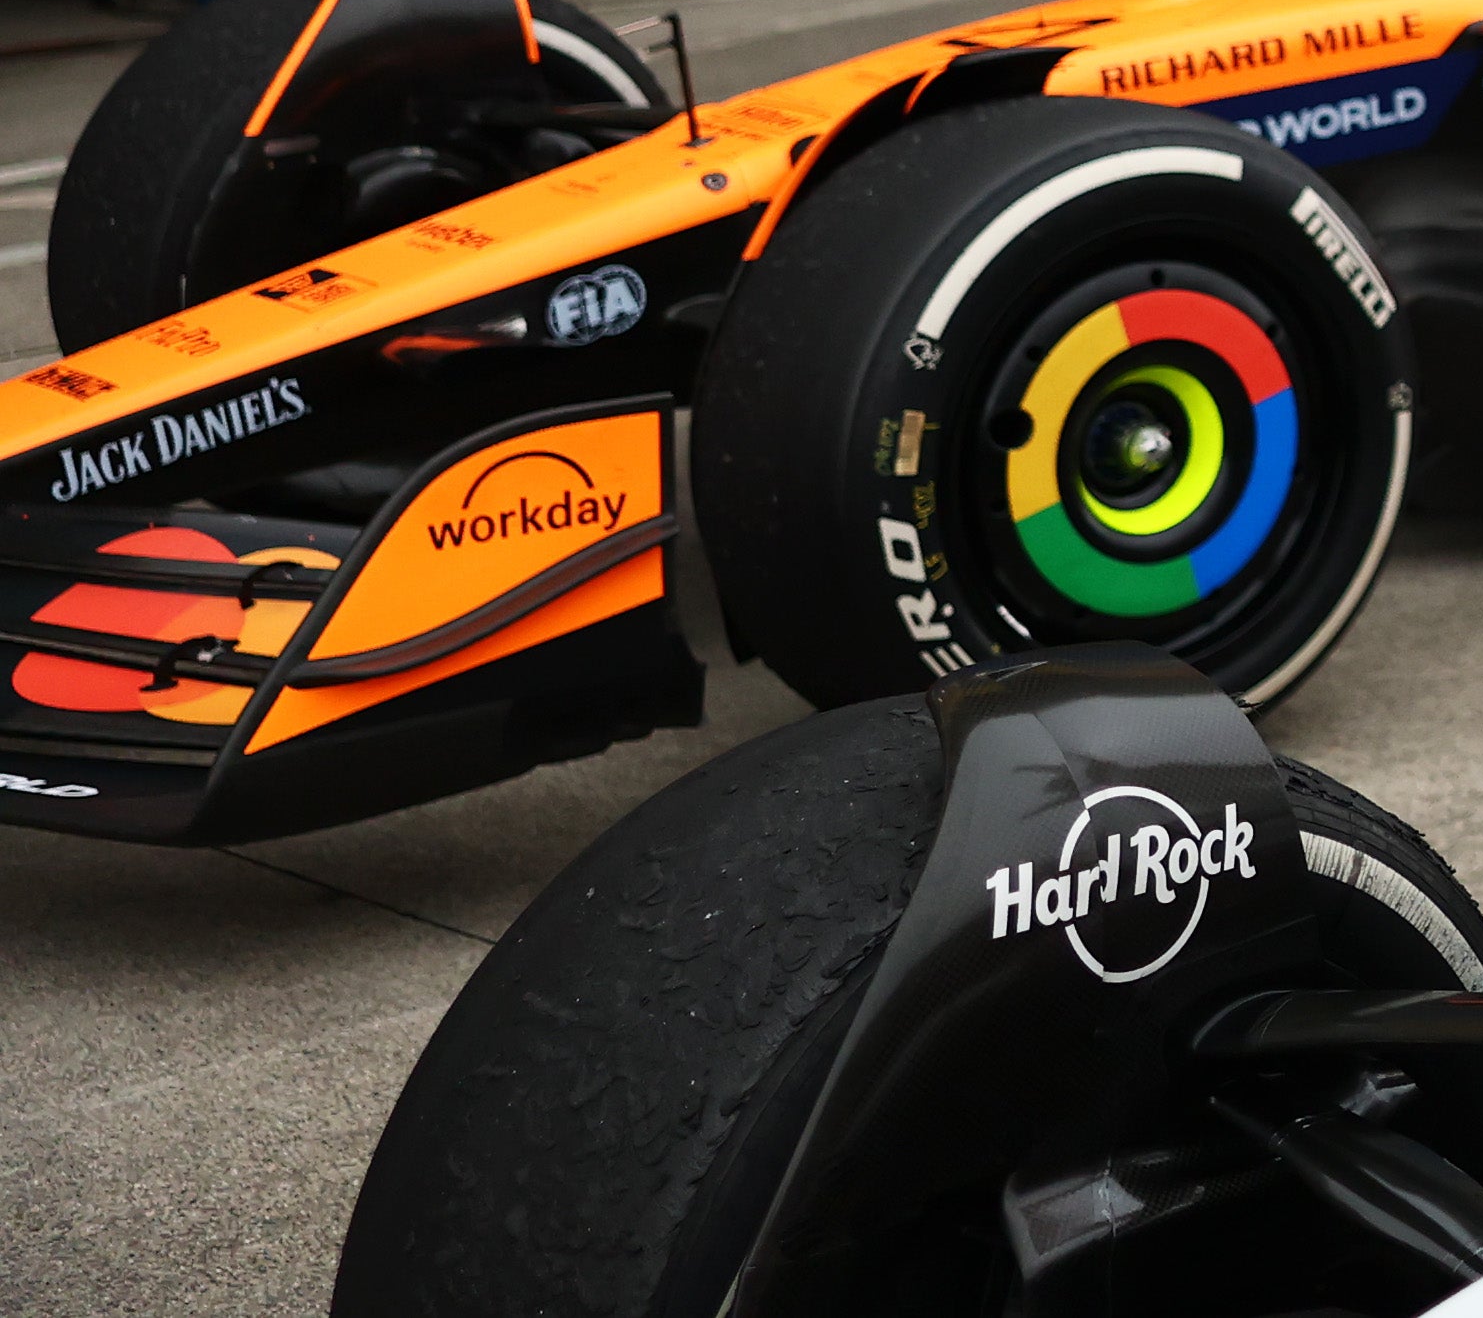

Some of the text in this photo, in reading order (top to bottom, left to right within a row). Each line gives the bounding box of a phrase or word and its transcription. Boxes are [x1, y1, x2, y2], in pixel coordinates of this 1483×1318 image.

[1100, 11, 1425, 97] RICHARD MILLE
[1267, 86, 1427, 150] WORLD
[552, 275, 644, 336] FIA
[1291, 187, 1397, 329] PIRELLI
[51, 377, 308, 503] JACK DANIEL'S
[427, 489, 628, 550] workday
[877, 515, 977, 680] ERO
[985, 802, 1257, 939] Hard Rock
